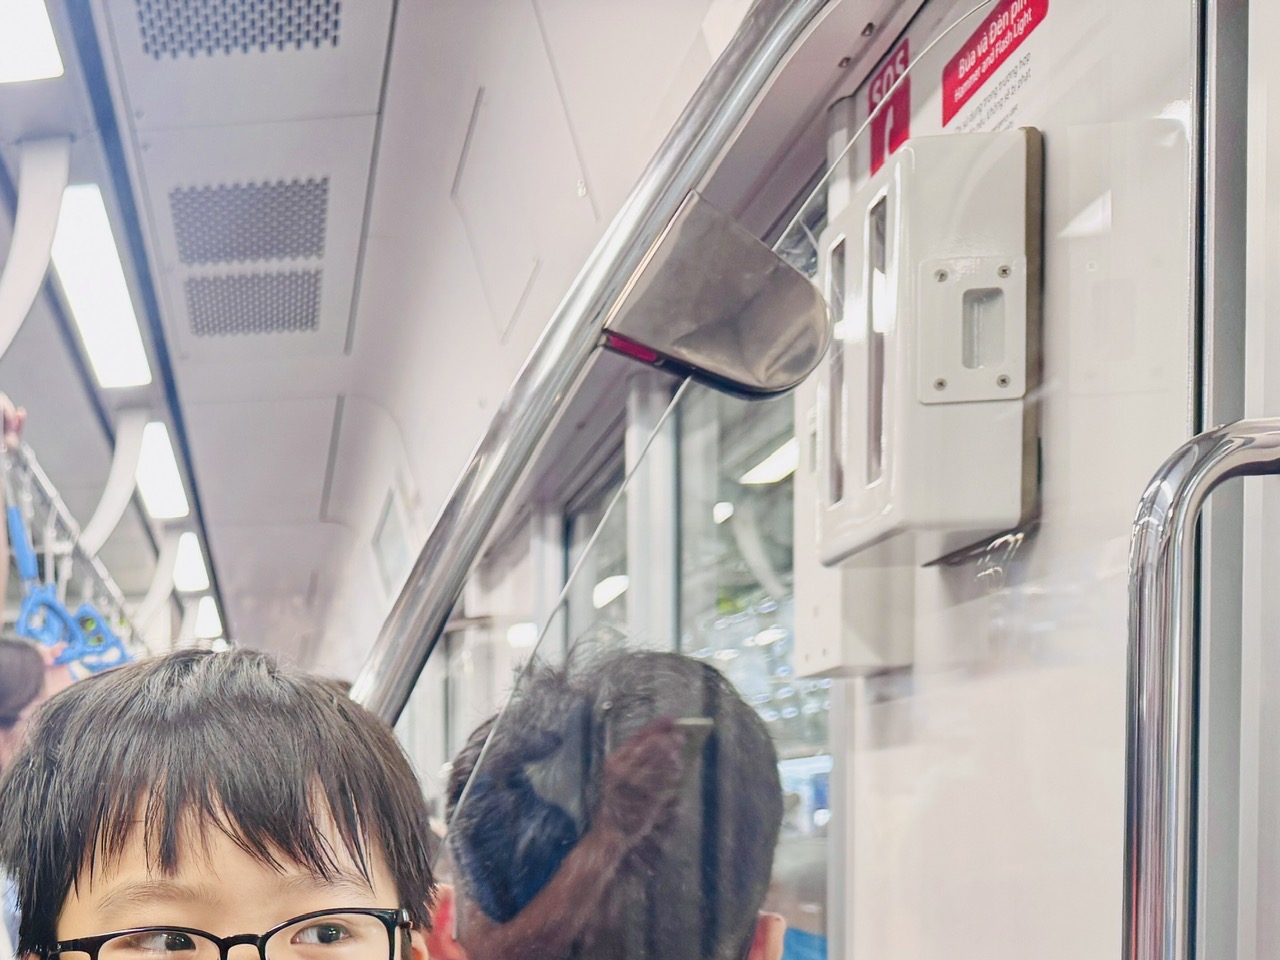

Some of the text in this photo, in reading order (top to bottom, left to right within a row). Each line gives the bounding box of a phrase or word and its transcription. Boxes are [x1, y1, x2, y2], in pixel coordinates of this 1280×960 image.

[954, 66, 981, 103] Hammer
[980, 47, 995, 74] and
[995, 30, 1013, 58] Flash
[1012, 7, 1032, 37] Light
